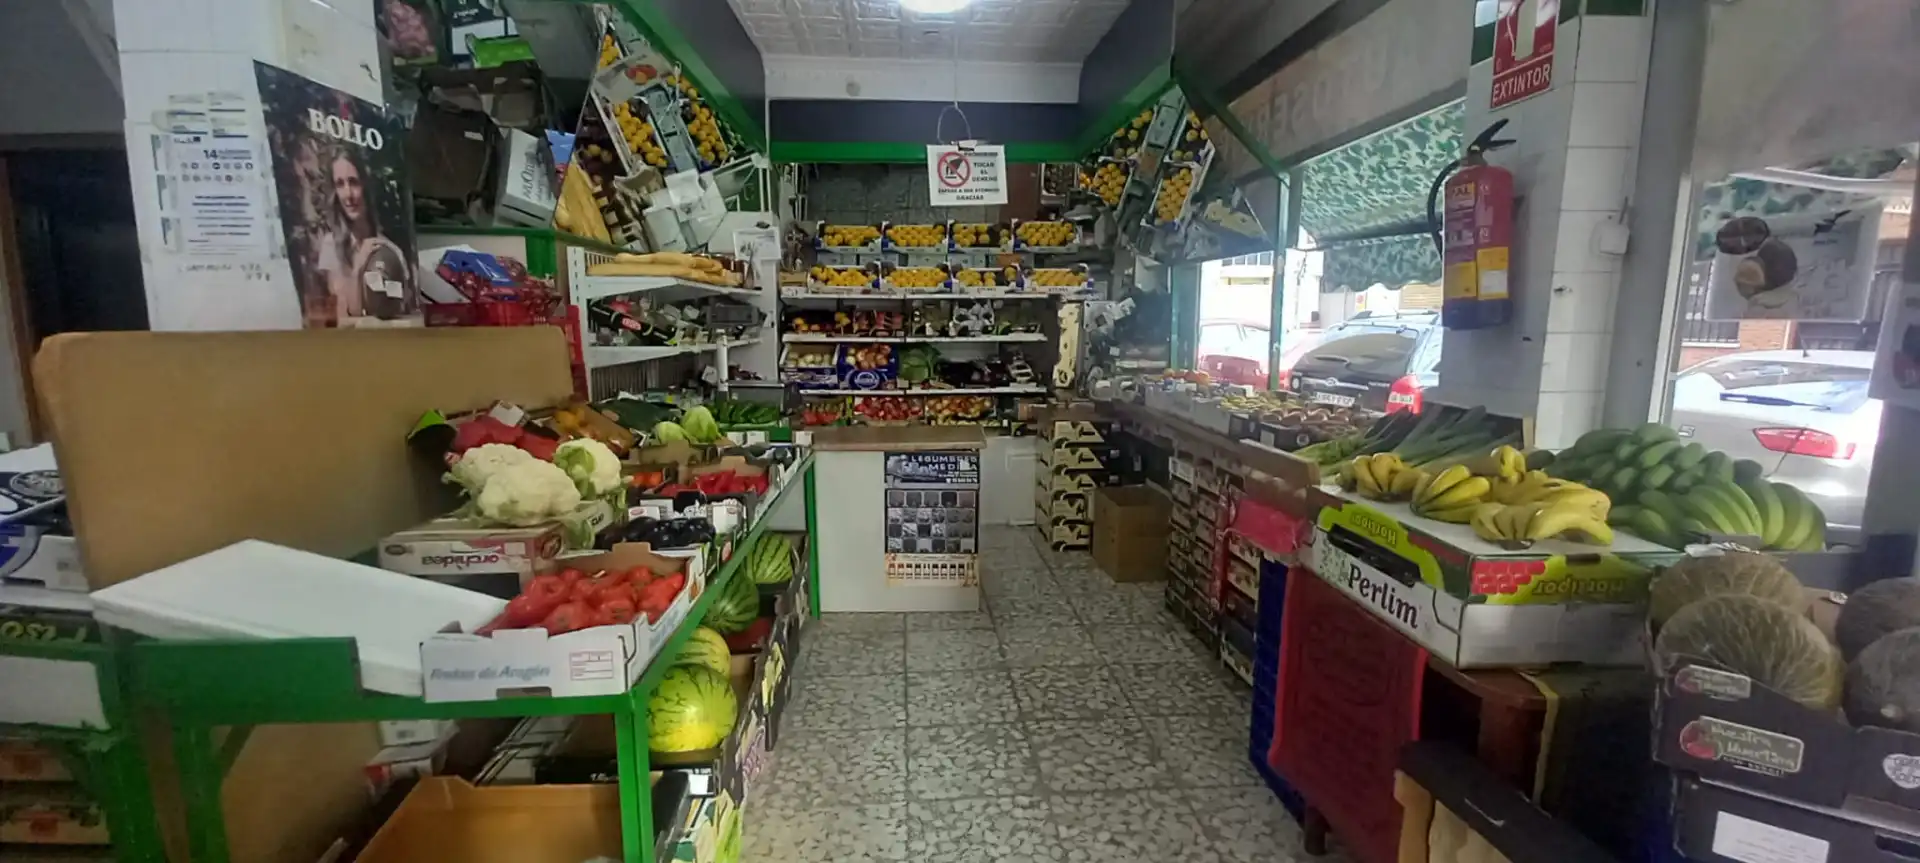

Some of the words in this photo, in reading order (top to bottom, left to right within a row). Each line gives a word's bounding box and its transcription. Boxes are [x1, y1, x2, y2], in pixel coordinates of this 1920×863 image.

[1493, 63, 1551, 102] EXTINTOR
[308, 108, 383, 150] BOLLO
[911, 455, 978, 463] LEGUMBRES
[929, 463, 978, 471] MEDIA
[1348, 562, 1418, 629] Perlim
